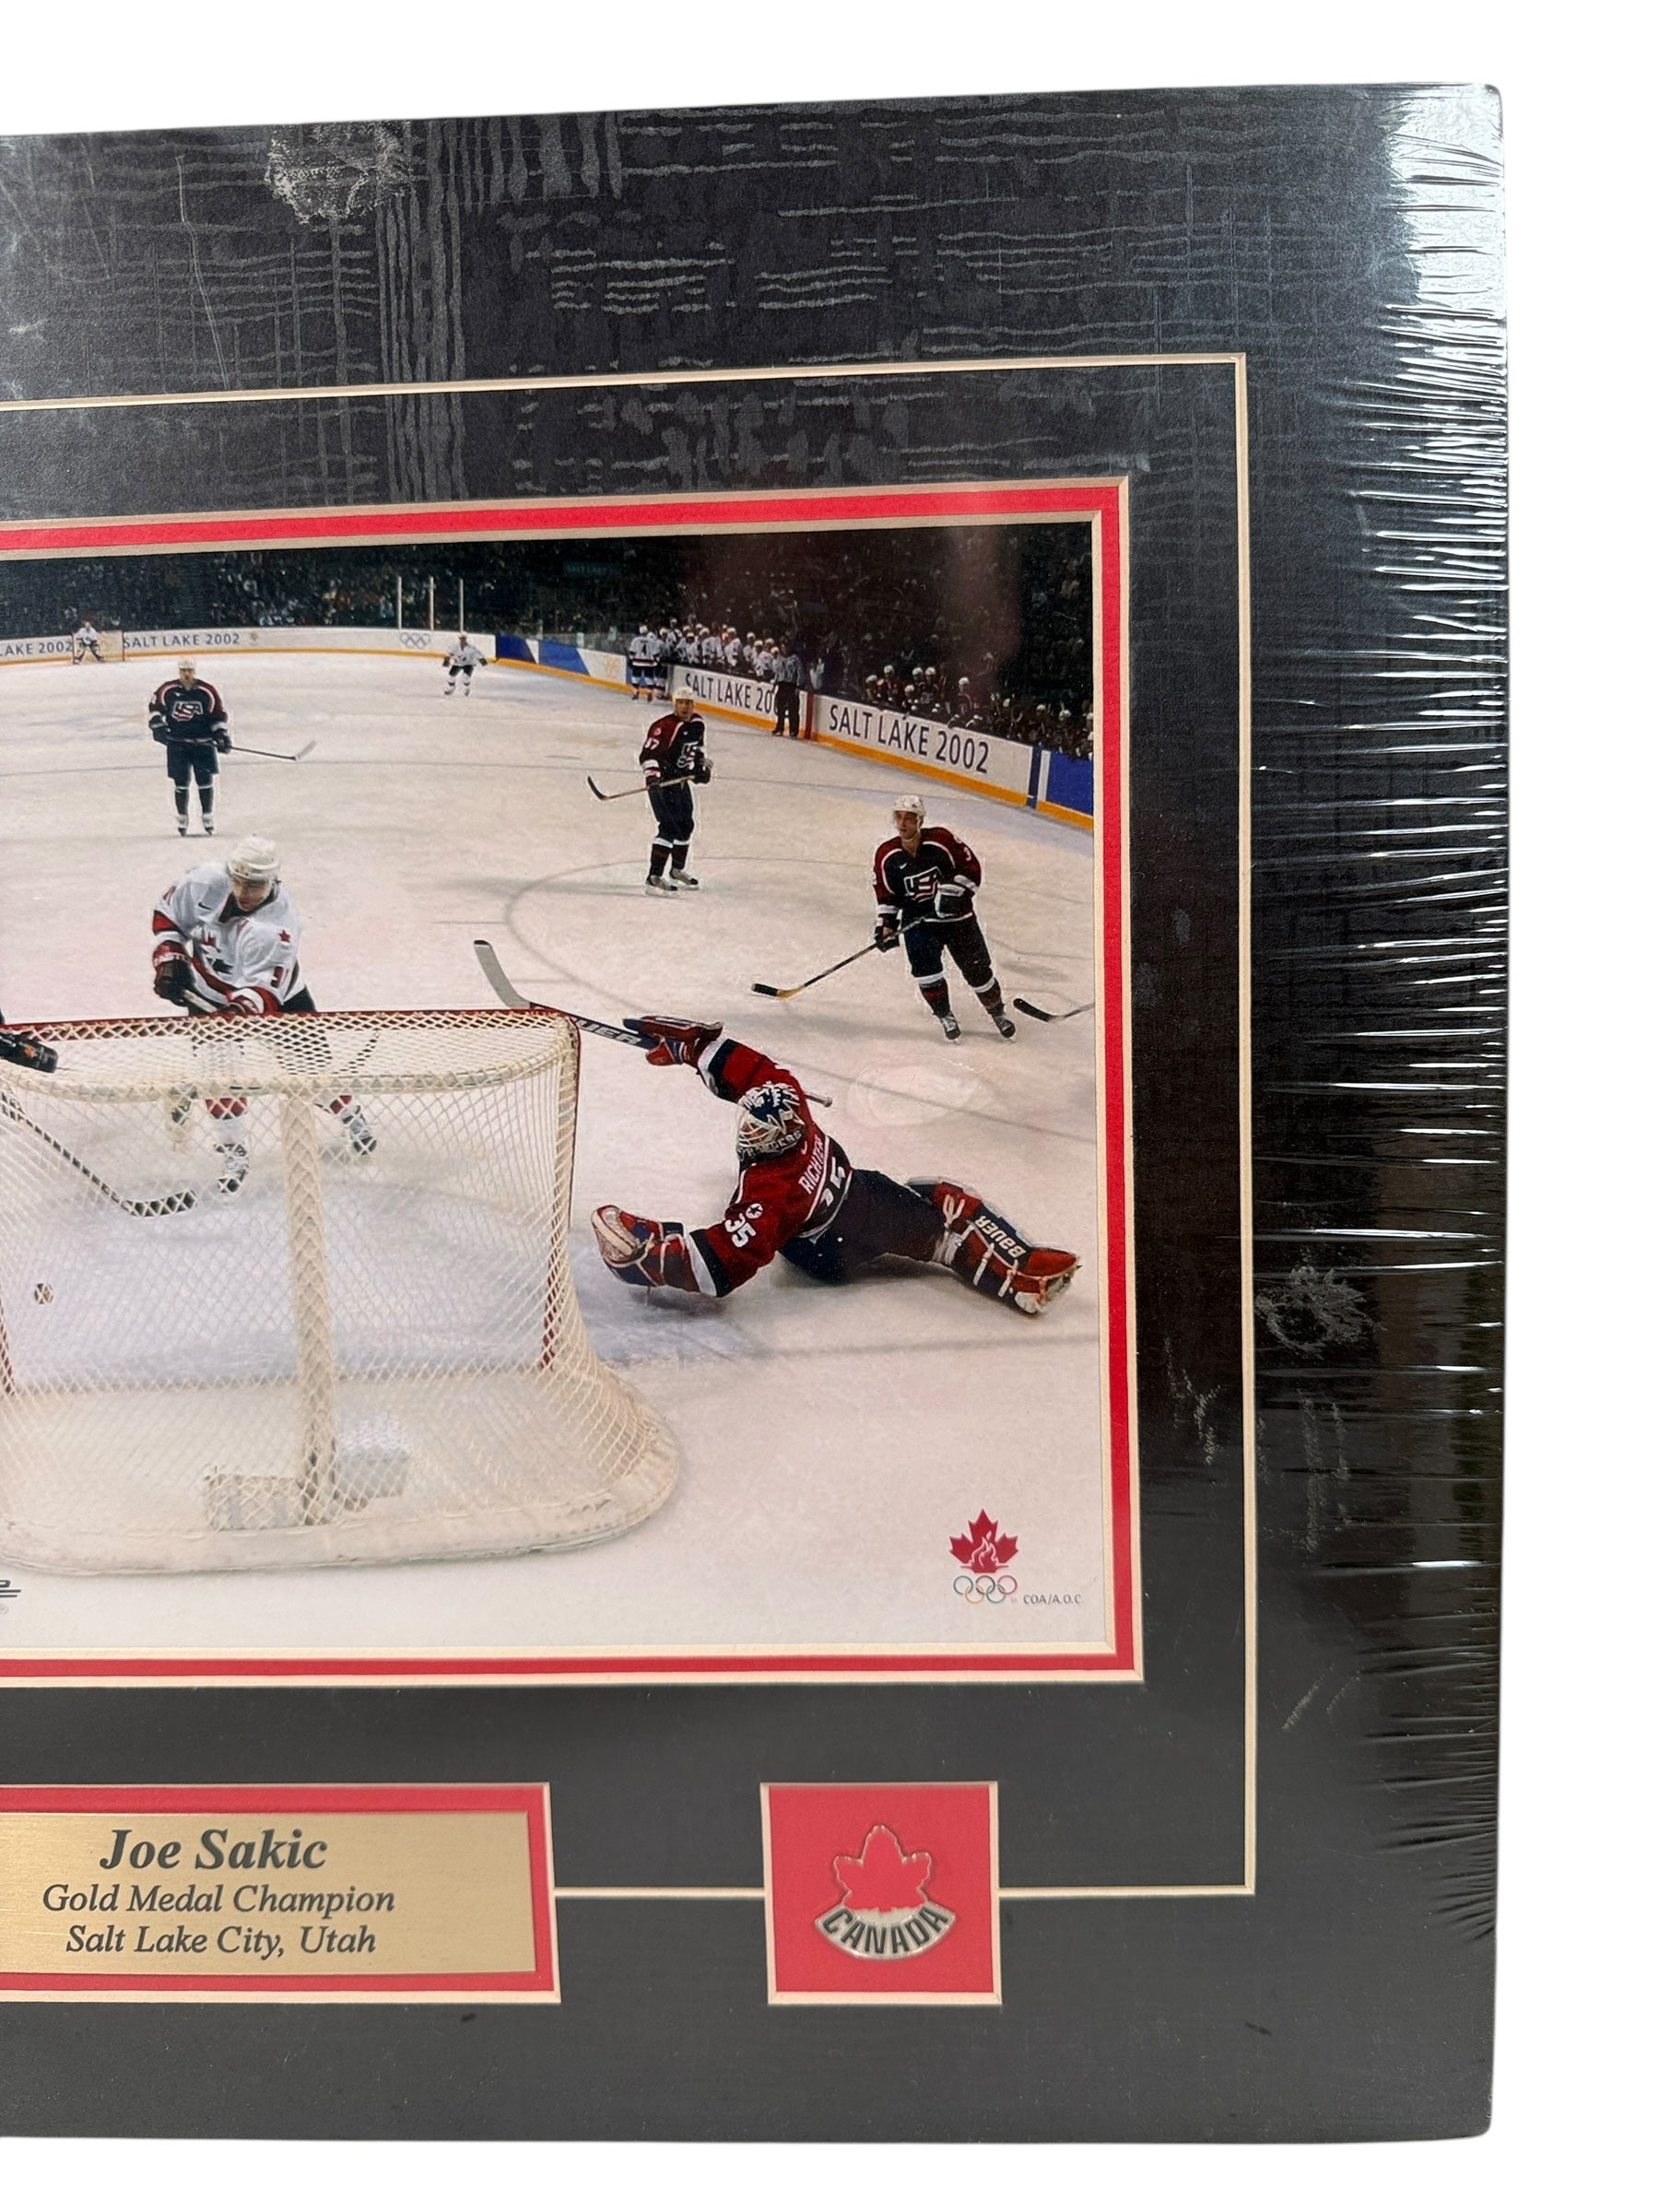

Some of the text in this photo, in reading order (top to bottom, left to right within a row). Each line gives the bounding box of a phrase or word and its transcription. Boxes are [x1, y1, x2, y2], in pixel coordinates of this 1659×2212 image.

[39, 640, 73, 653] 2002
[124, 632, 241, 649] SALT LAKE 2002
[685, 673, 778, 715] SALT LAKE 20
[830, 704, 989, 774] SALT LAKE 2002
[724, 1212, 757, 1248] 35
[974, 1215, 1027, 1258] BAUER
[99, 1828, 329, 1869] Joe Sakic
[42, 1883, 396, 1920] Gold Medal Champion
[65, 1924, 377, 1961] Salt Lake City, Utah
[822, 1905, 949, 1954] CANADA
